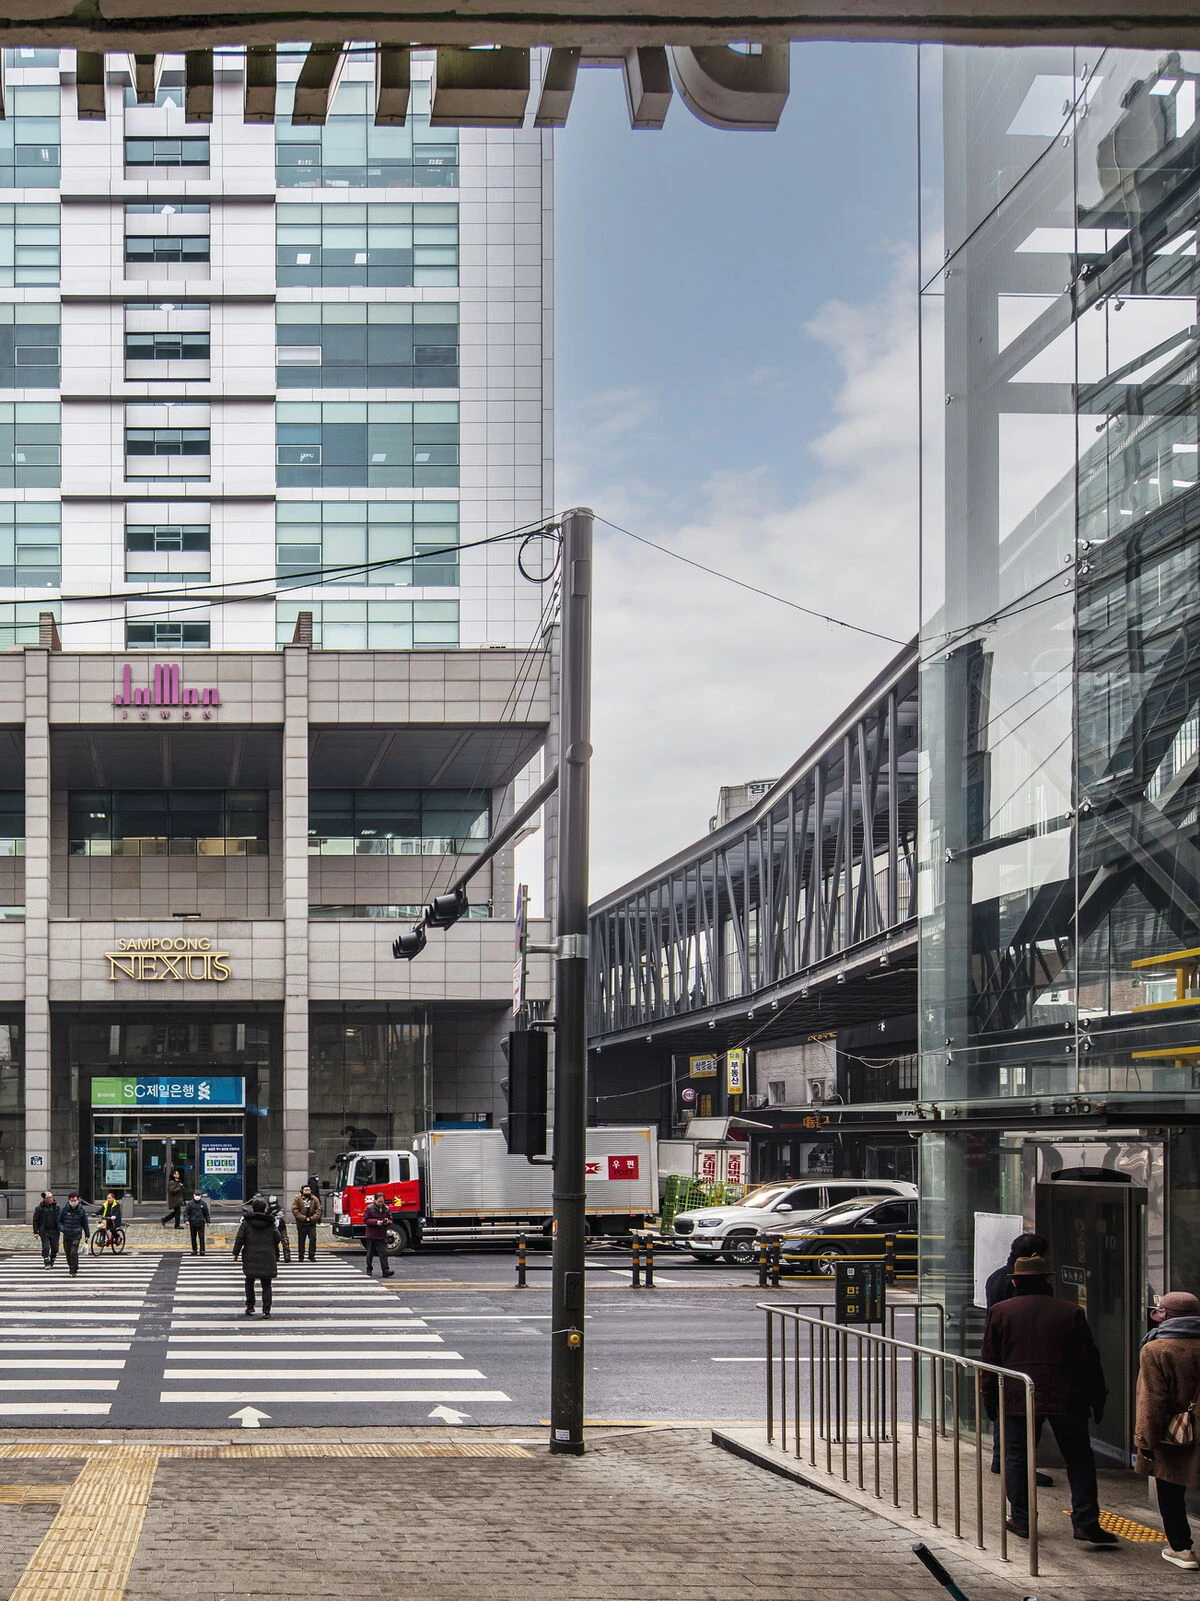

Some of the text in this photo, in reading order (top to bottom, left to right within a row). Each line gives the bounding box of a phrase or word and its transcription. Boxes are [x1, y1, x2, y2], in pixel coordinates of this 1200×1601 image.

[118, 937, 211, 951] SAMPOONG
[104, 951, 232, 981] NEXUS
[731, 1061, 739, 1085] 부동산
[123, 1083, 194, 1098] SC제일은행
